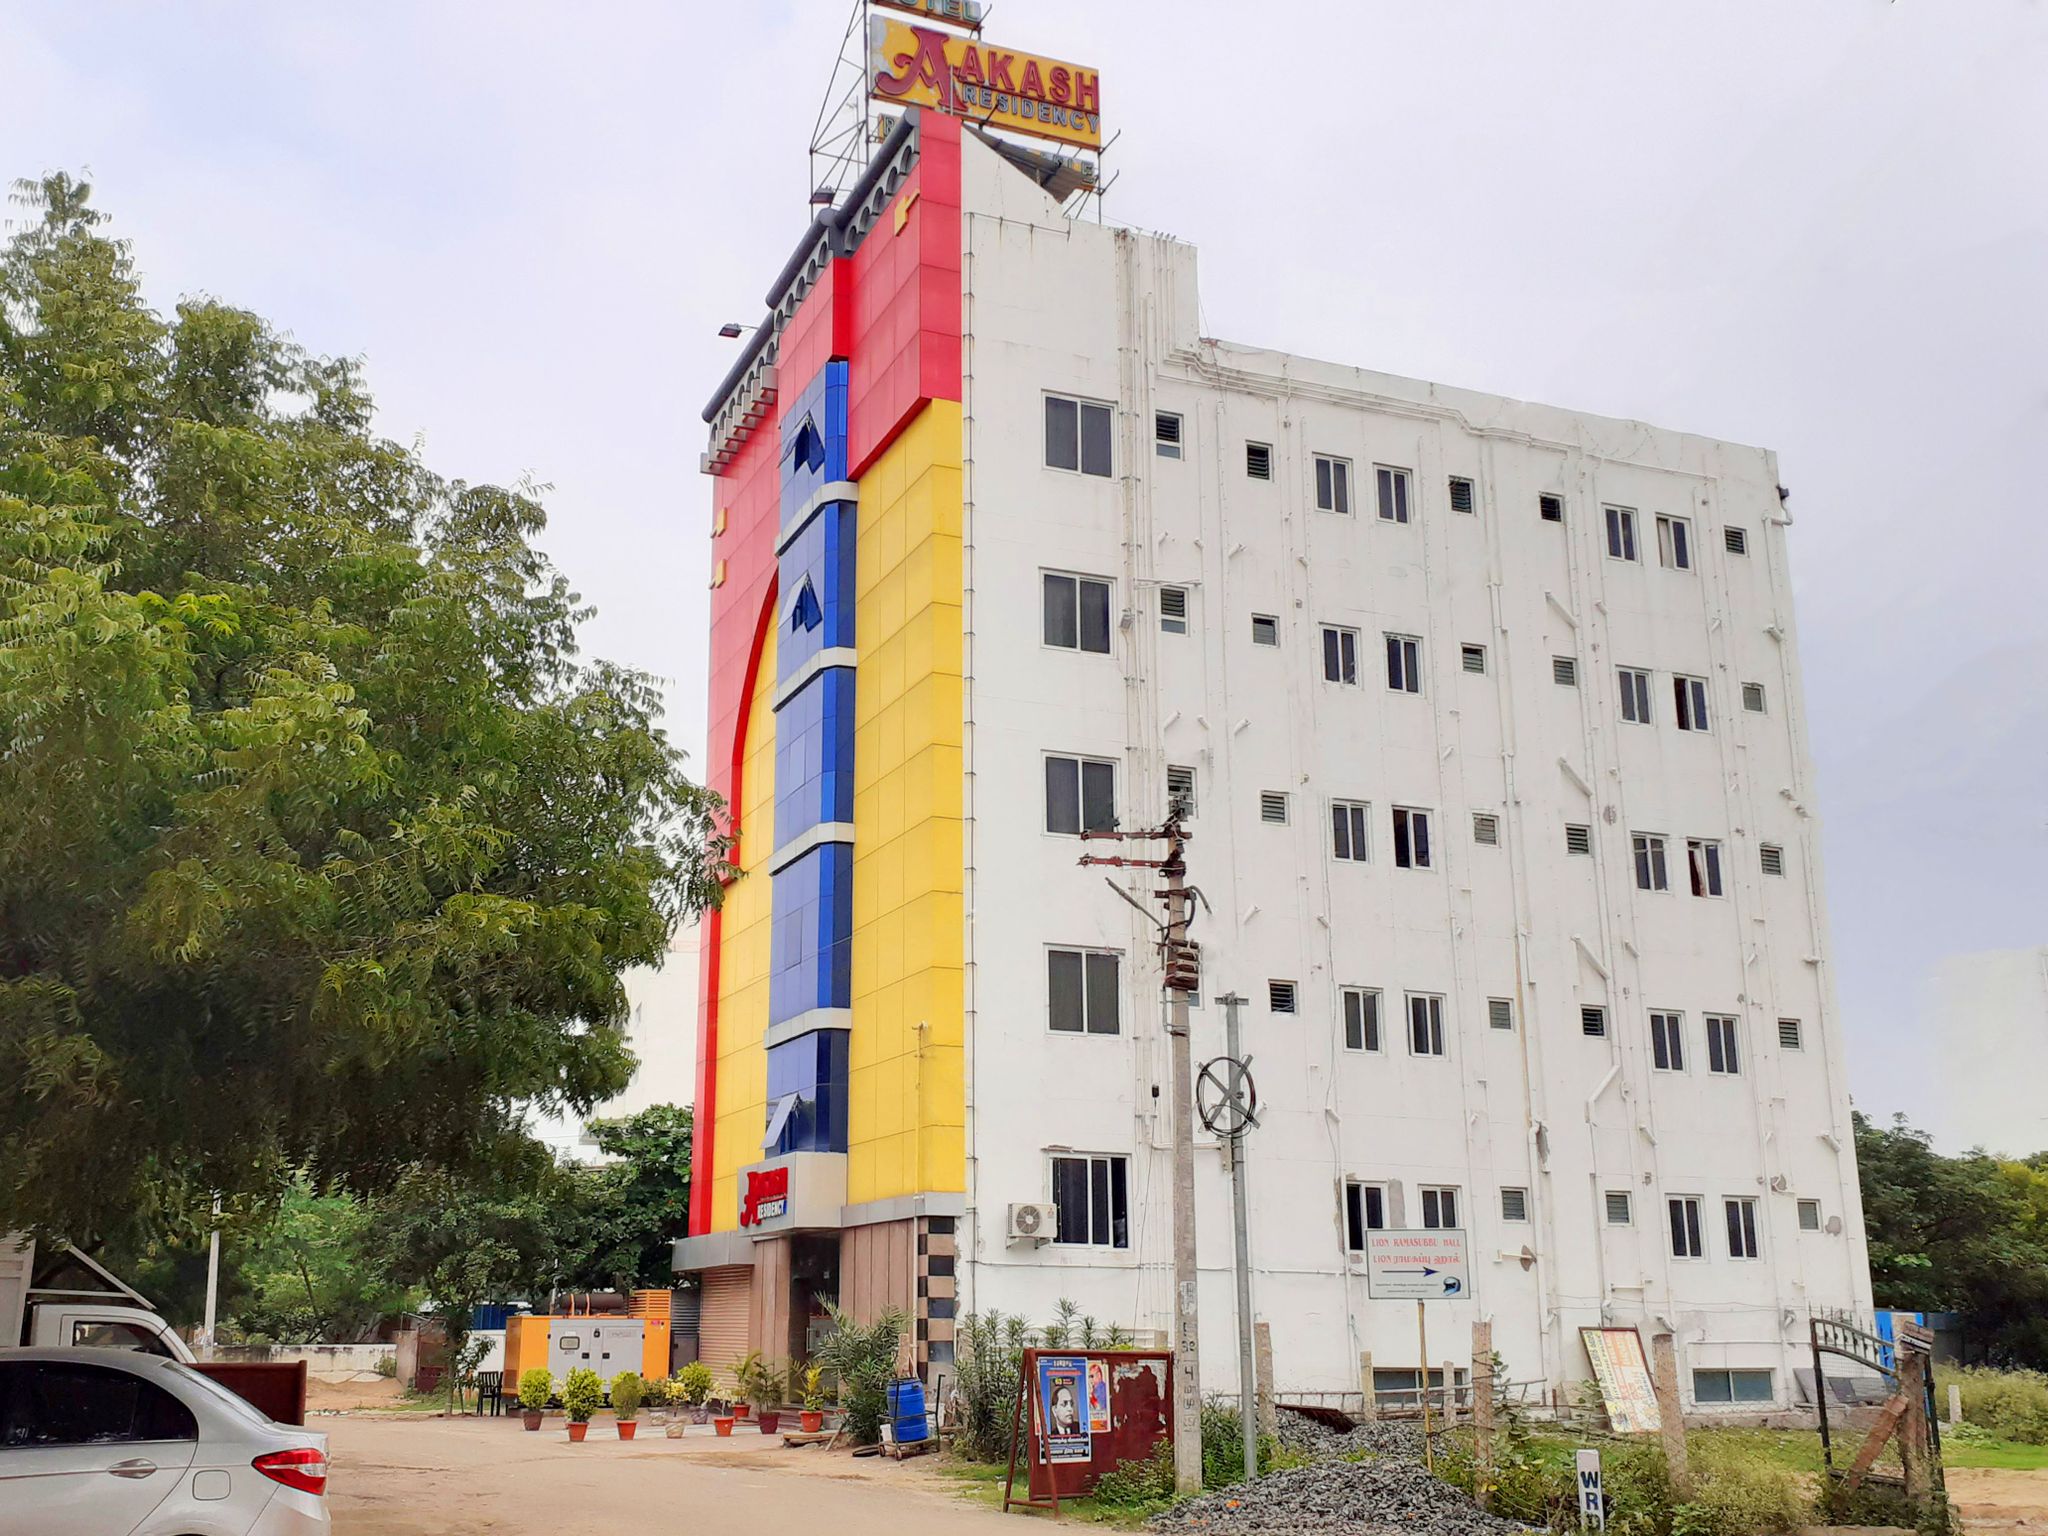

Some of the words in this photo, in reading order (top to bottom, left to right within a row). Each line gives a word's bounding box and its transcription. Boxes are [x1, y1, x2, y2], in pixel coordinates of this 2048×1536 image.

[876, 26, 1099, 113] AAKASH
[963, 84, 1100, 134] RESIDENCY
[1371, 1239, 1389, 1247] LION
